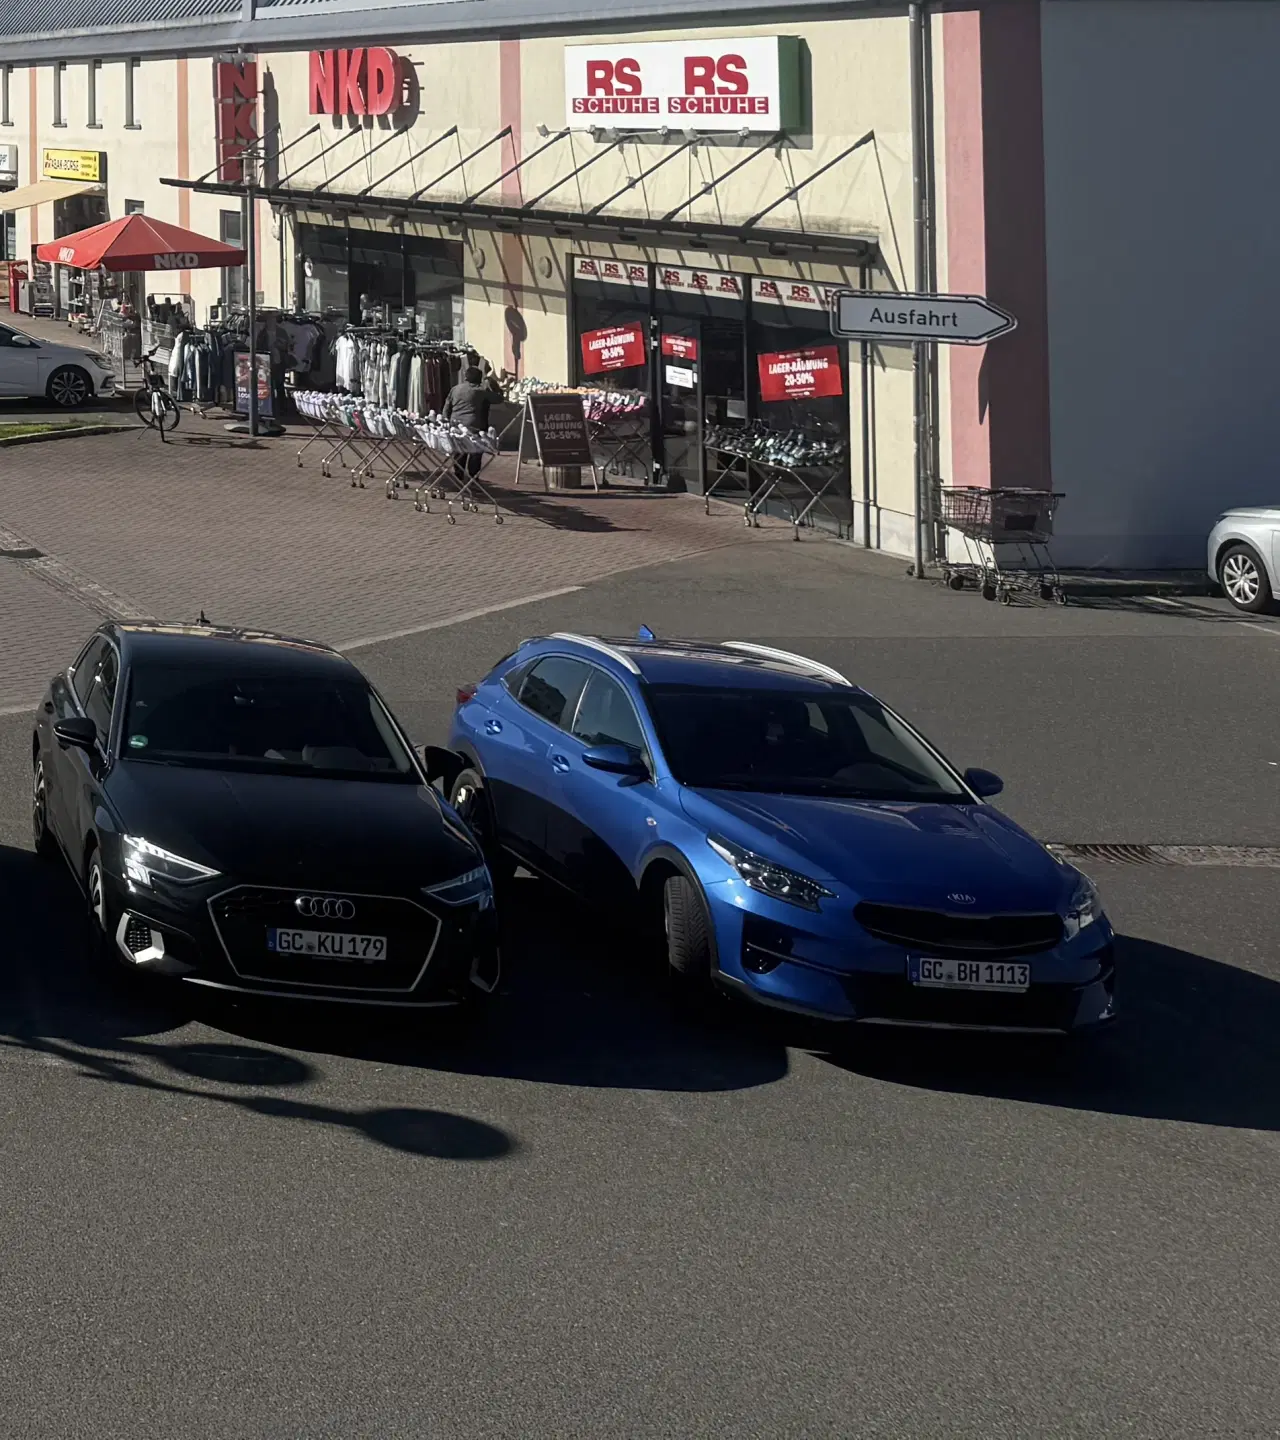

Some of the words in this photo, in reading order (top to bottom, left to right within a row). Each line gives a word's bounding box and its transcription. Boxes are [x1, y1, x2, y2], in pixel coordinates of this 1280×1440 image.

[309, 48, 403, 115] NKD
[586, 57, 643, 97] RS
[683, 53, 749, 96] RS
[574, 97, 659, 113] SCHUHE
[669, 96, 768, 114] SCHUHE
[58, 246, 76, 262] NKD
[154, 253, 199, 269] NKD
[580, 260, 595, 271] RS
[604, 263, 619, 274] RS
[629, 266, 645, 277] RS
[663, 270, 680, 282] RS
[691, 272, 708, 285] RS
[720, 276, 737, 288] RS
[760, 281, 777, 293] RS
[791, 284, 810, 298] RS
[869, 307, 958, 327] Ausfahrt
[601, 345, 625, 360] 20-50%
[768, 357, 829, 375] LAGER-RÄUMUNG
[784, 372, 815, 386] 20-50%
[544, 431, 581, 440] 20-50%
[278, 931, 304, 951] GC
[317, 934, 343, 955] KU
[347, 936, 385, 957] 179
[921, 960, 943, 980] GC
[957, 962, 980, 983] BH
[984, 964, 1028, 985] 1113
